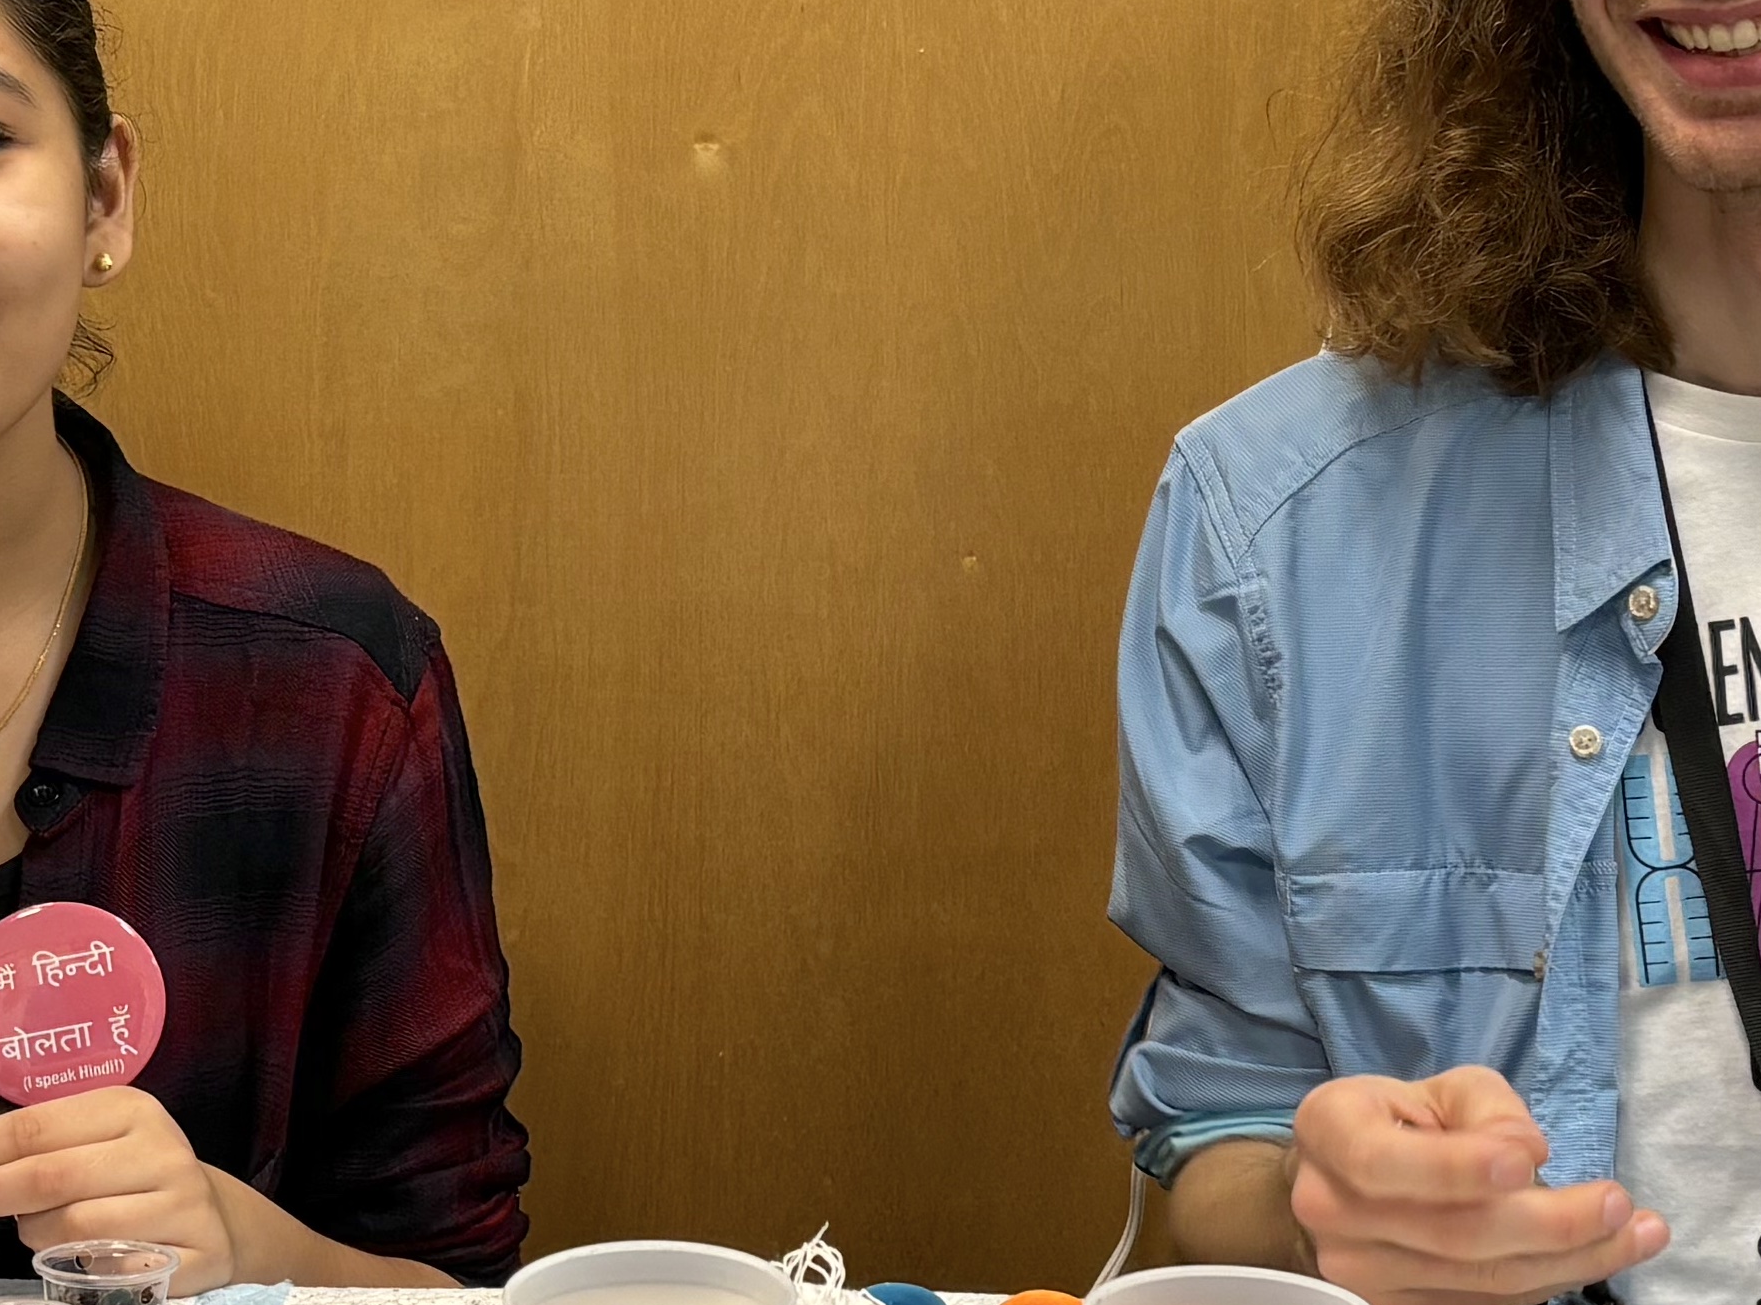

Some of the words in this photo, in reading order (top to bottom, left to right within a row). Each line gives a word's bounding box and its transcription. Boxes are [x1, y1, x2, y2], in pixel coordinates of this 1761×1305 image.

[32, 940, 115, 987] हिन्दी
[108, 1003, 139, 1056] हूँ
[35, 1068, 77, 1090] speak
